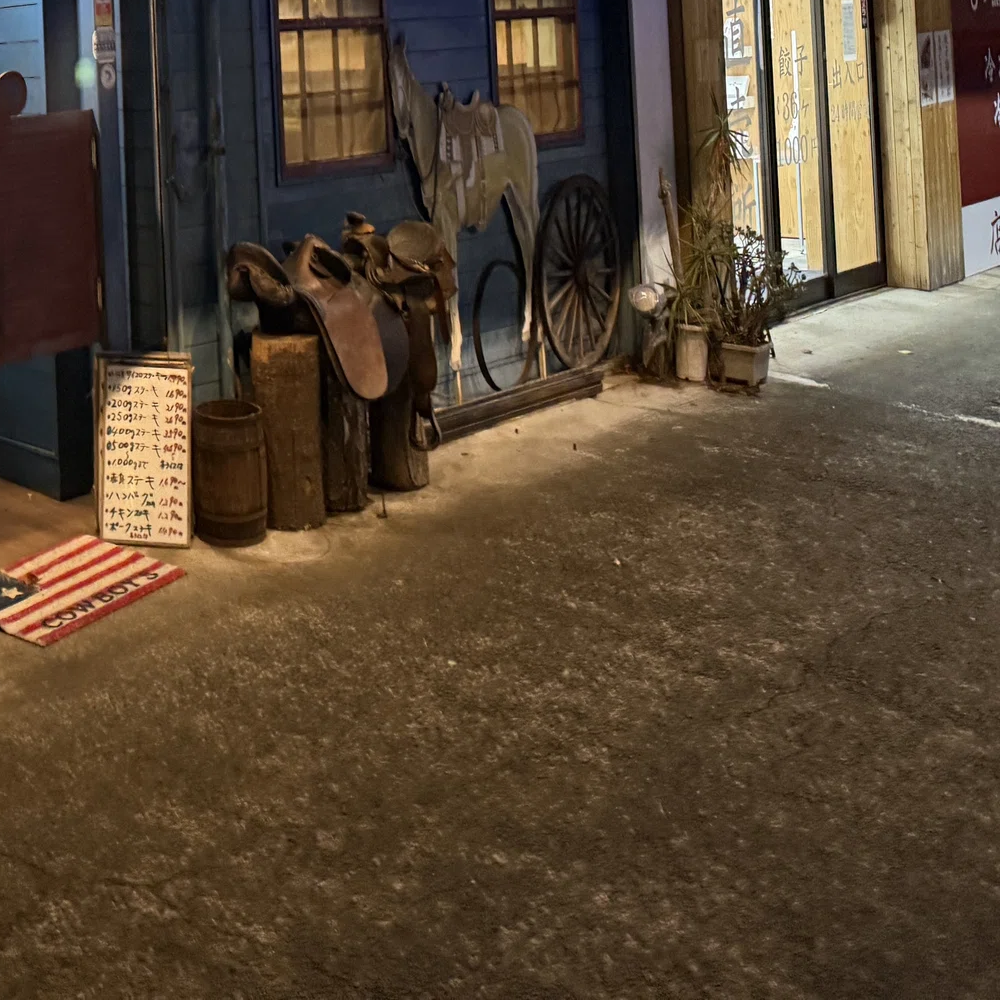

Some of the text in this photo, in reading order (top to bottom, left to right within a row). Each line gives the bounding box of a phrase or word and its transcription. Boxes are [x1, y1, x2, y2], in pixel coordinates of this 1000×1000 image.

[778, 45, 808, 79] 餃子
[831, 60, 864, 89] 出入口
